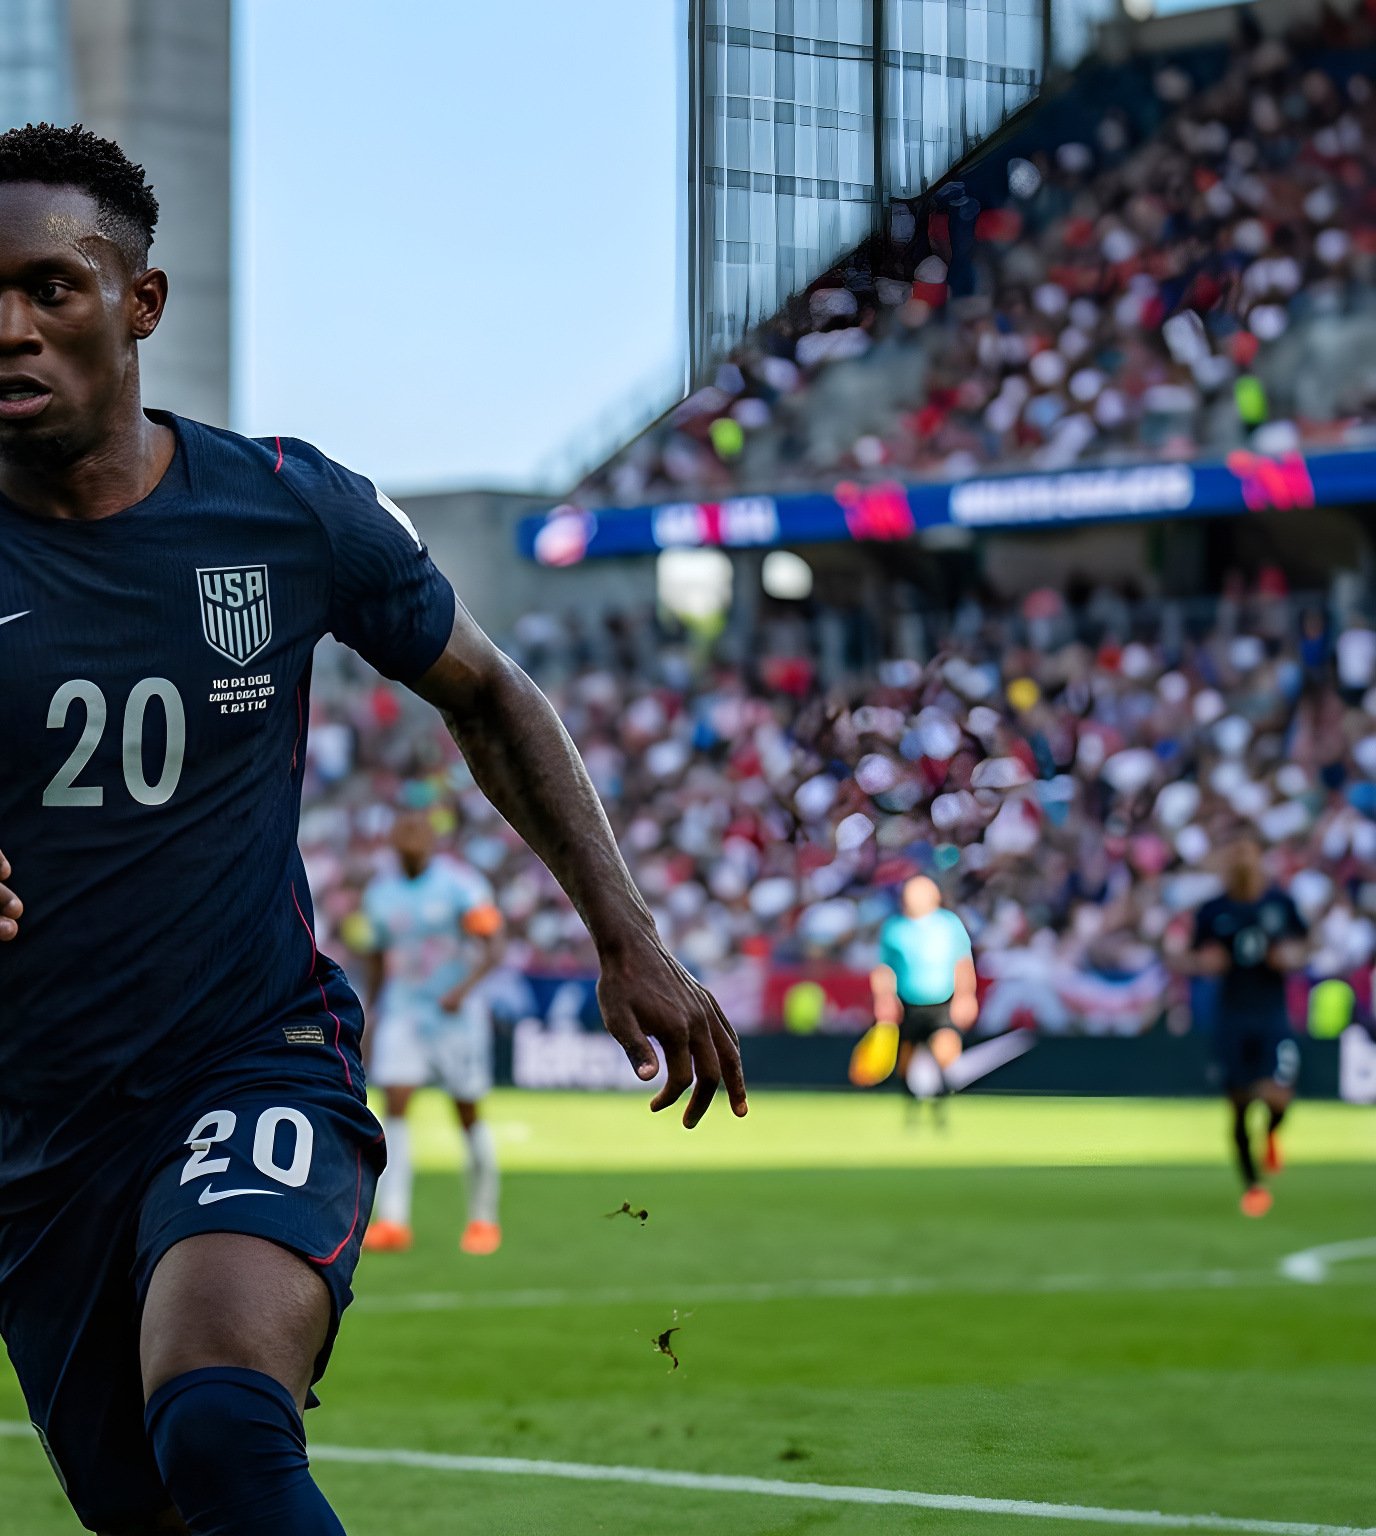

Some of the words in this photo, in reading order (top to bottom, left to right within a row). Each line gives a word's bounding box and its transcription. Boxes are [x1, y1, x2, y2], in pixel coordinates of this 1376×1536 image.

[203, 571, 264, 608] USA
[42, 677, 186, 807] 20
[179, 1106, 314, 1188] 20
